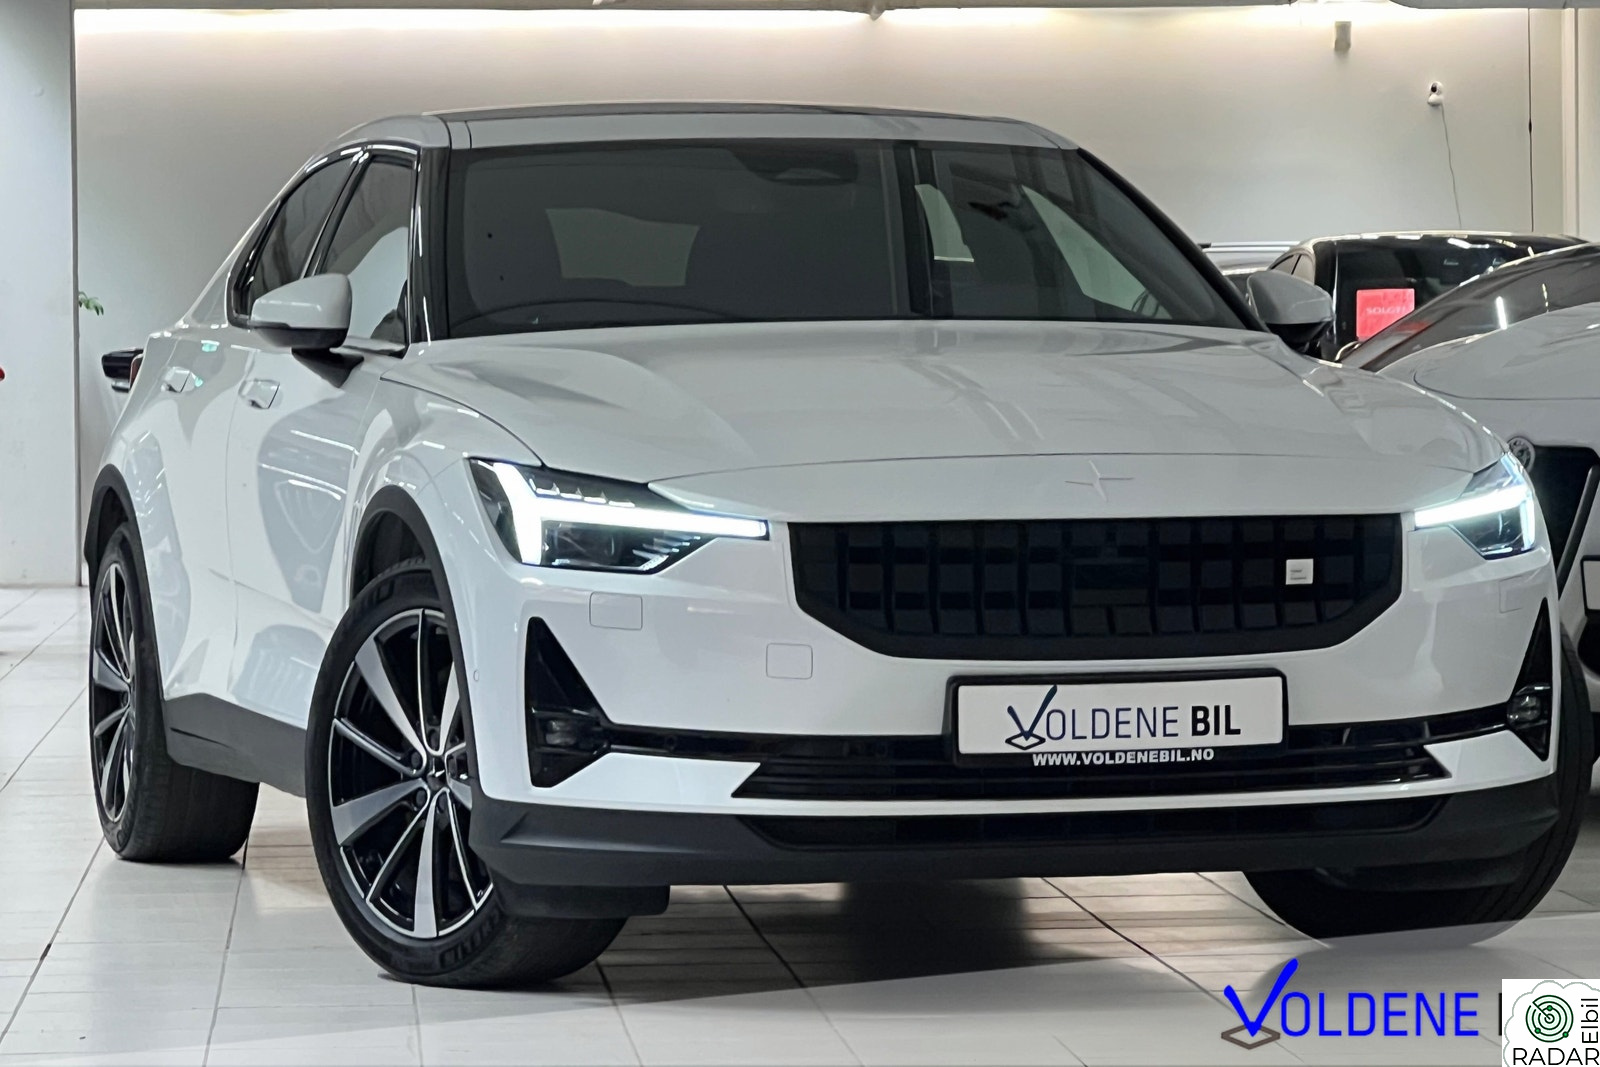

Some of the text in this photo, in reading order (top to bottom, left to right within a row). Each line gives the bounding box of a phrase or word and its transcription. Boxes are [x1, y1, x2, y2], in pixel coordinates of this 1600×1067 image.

[1007, 684, 1242, 741] VOLDENE BIL
[1032, 748, 1215, 767] WWW.VOLDENEBIL.NO
